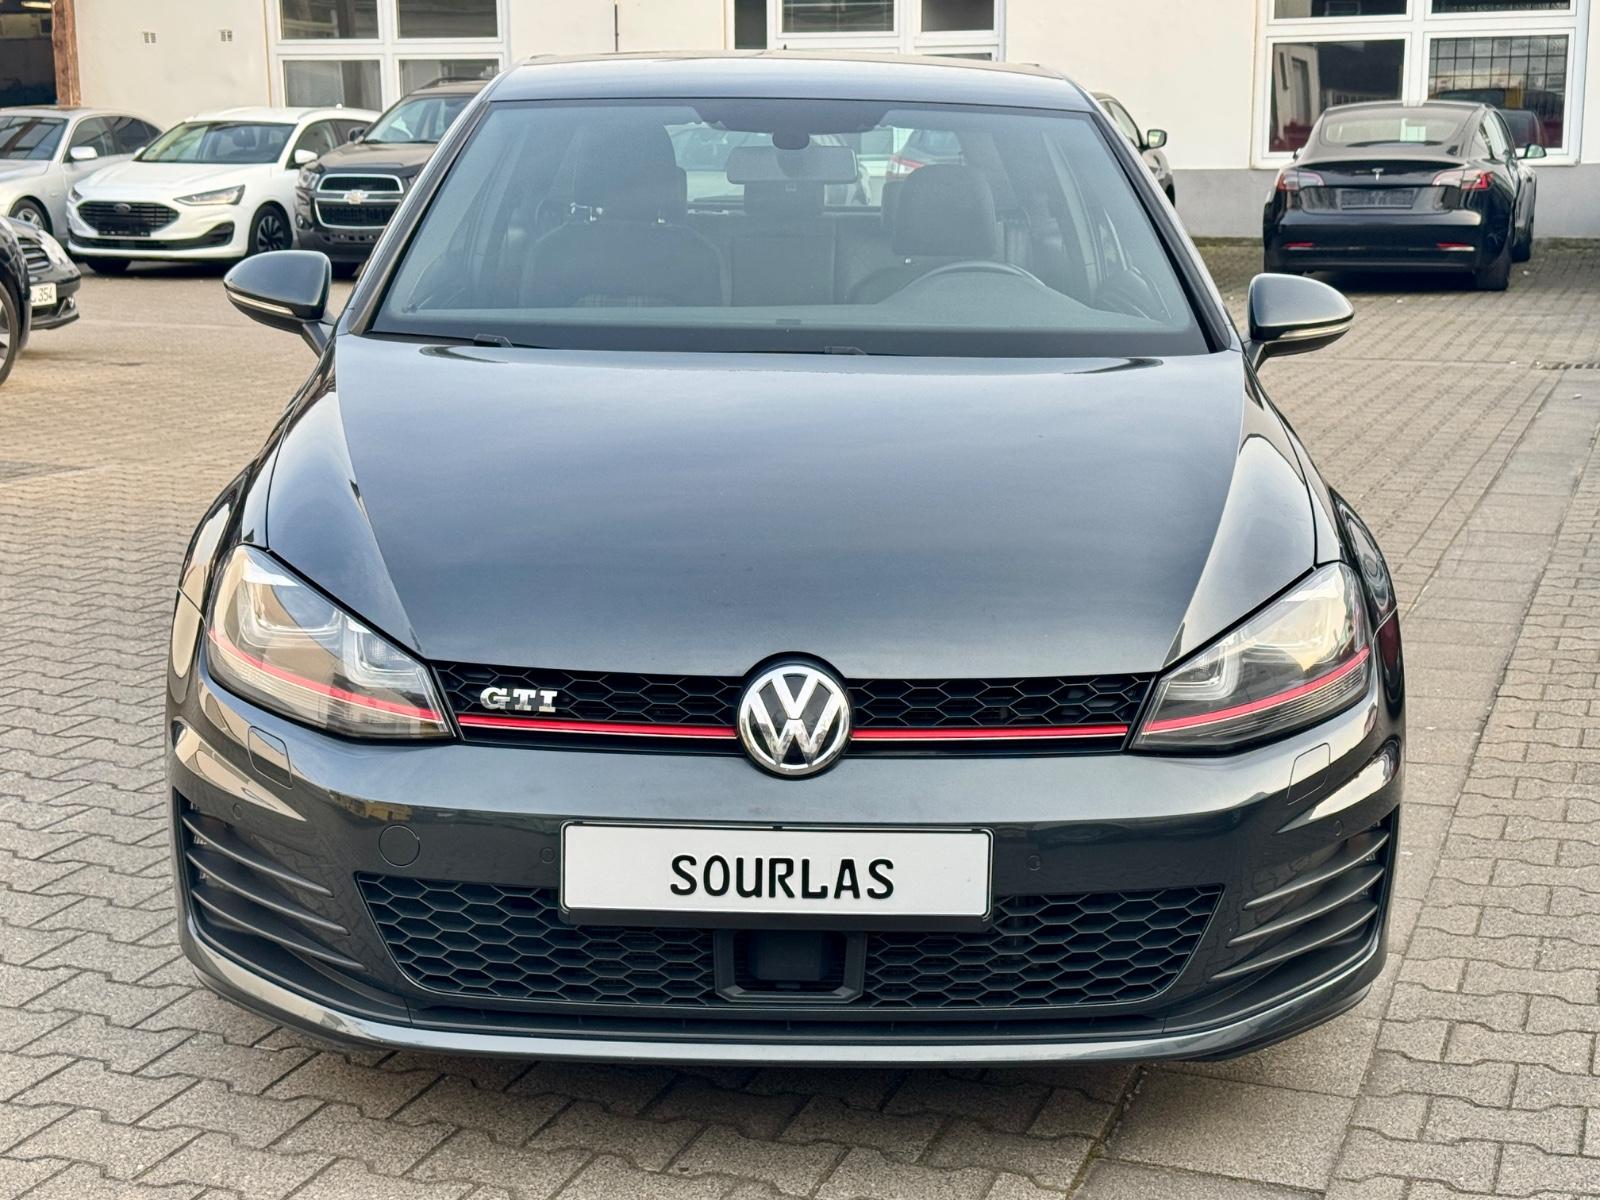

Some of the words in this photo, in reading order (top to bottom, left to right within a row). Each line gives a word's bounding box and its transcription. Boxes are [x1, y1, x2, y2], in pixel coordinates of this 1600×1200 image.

[38, 286, 53, 302] 354
[480, 686, 556, 713] GTI
[671, 854, 895, 899] SOURLAS
